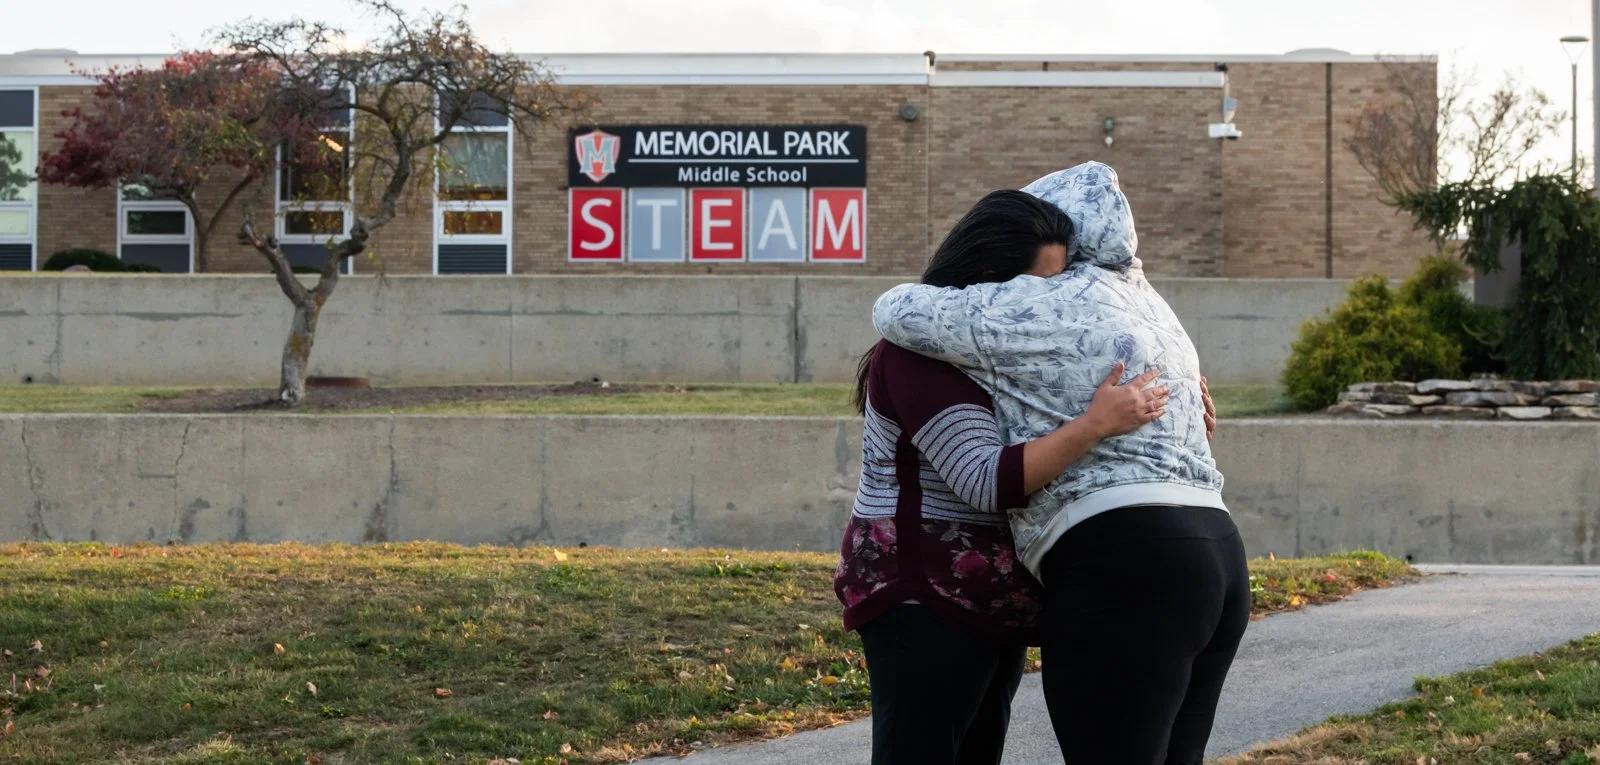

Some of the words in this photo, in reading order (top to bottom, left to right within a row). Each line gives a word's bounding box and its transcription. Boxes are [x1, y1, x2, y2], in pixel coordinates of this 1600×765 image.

[579, 138, 616, 174] M
[634, 131, 778, 156] MEMORIAL
[783, 131, 851, 156] PARK
[678, 166, 740, 182] Middle
[746, 166, 807, 182] School
[579, 198, 861, 251] STEAM
